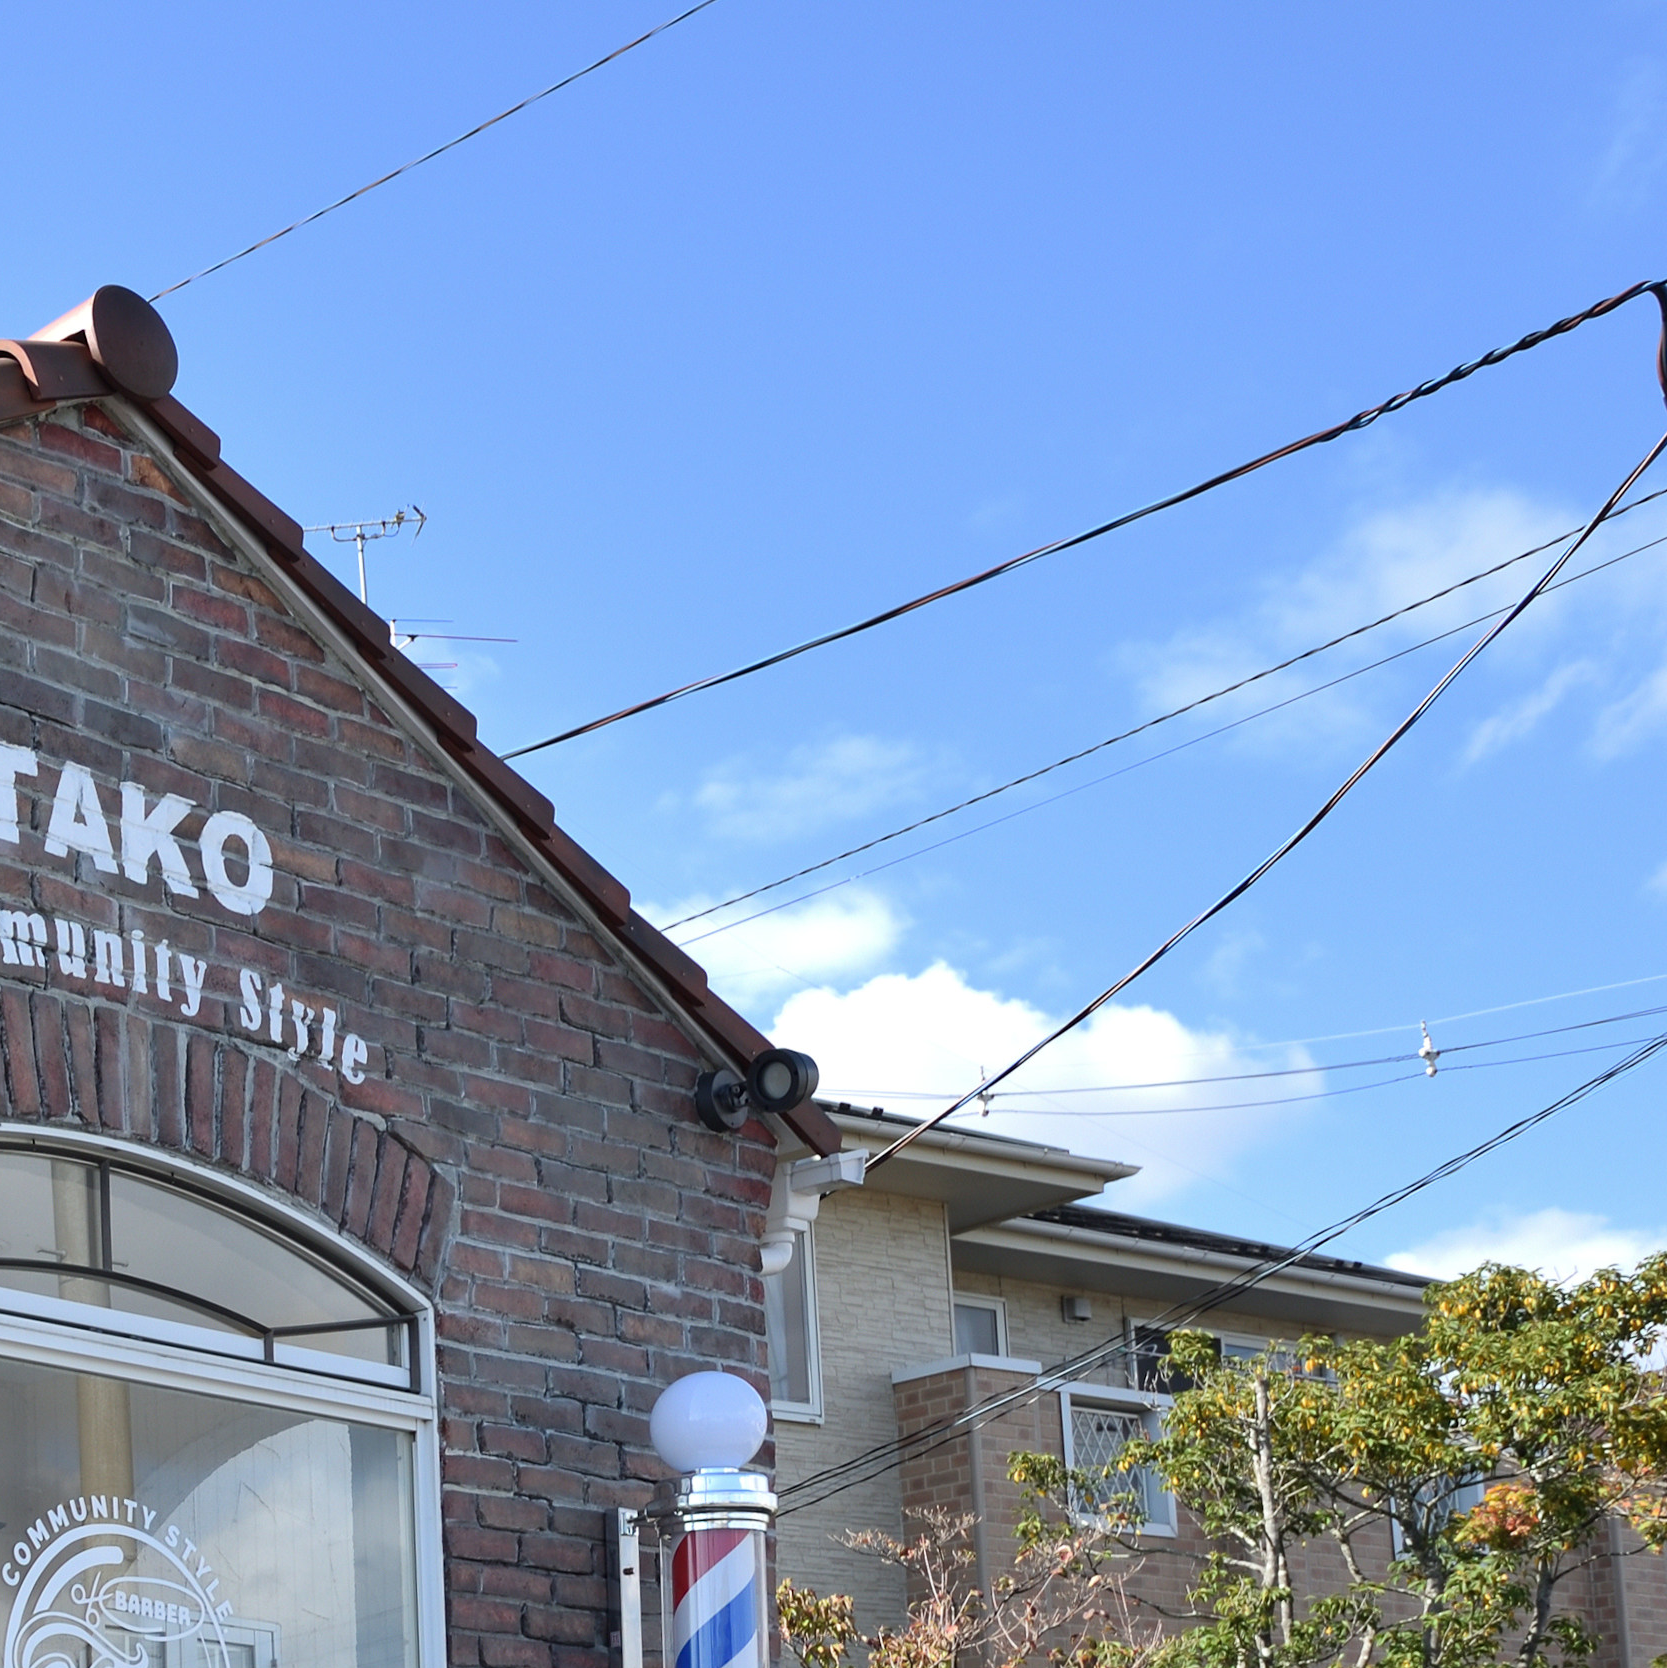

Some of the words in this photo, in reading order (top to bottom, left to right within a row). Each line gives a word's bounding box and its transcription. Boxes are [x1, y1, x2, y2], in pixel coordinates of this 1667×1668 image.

[238, 966, 369, 1085] Style
[1, 1493, 157, 1588] COMMUNITY
[114, 1590, 192, 1627] BARBER
